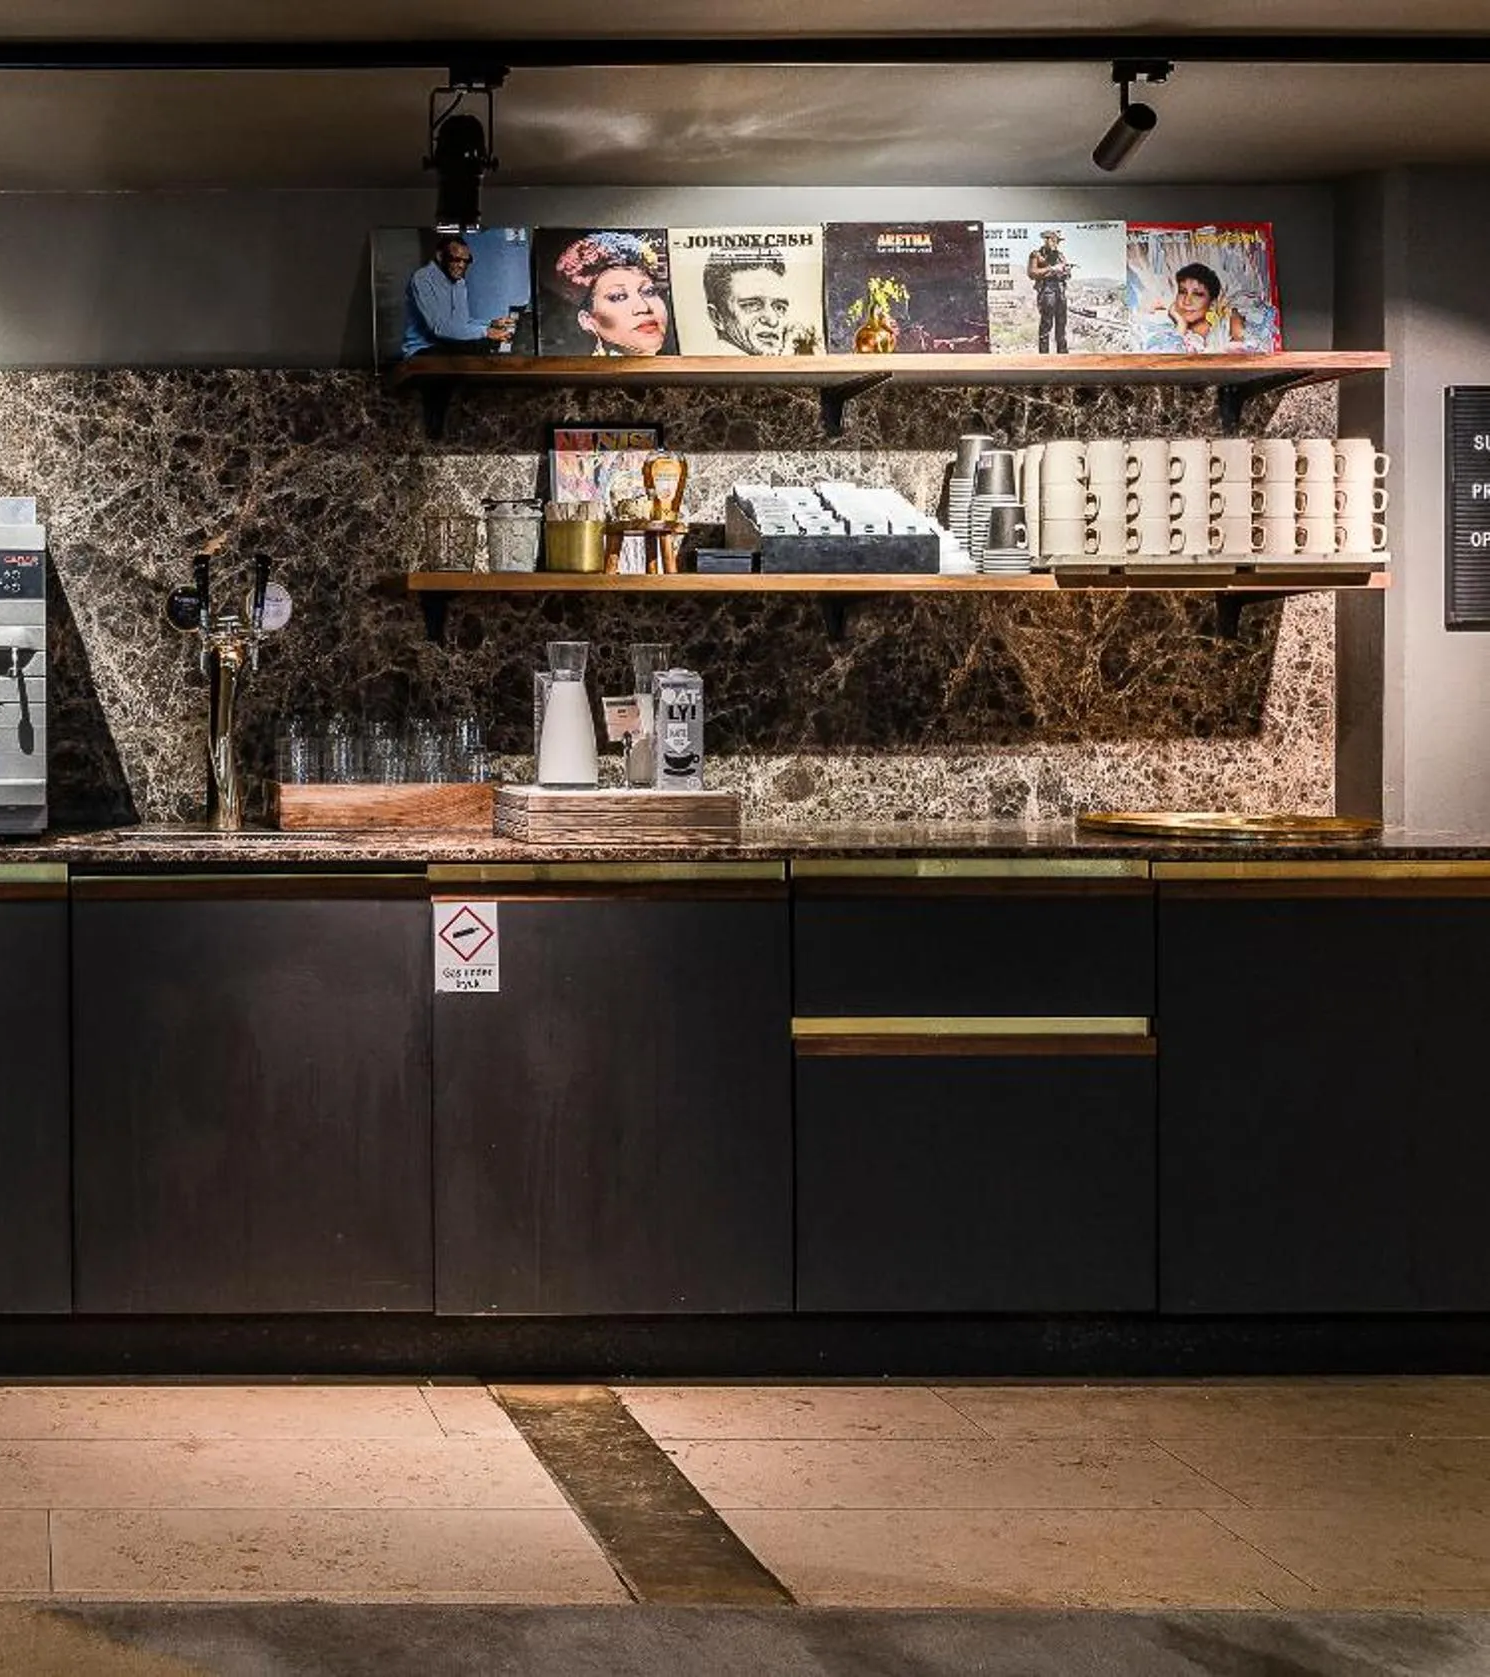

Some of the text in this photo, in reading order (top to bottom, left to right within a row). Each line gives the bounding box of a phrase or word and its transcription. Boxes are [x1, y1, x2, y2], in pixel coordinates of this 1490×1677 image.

[682, 234, 814, 249] JOHNNY CASH
[668, 704, 697, 721] LY!
